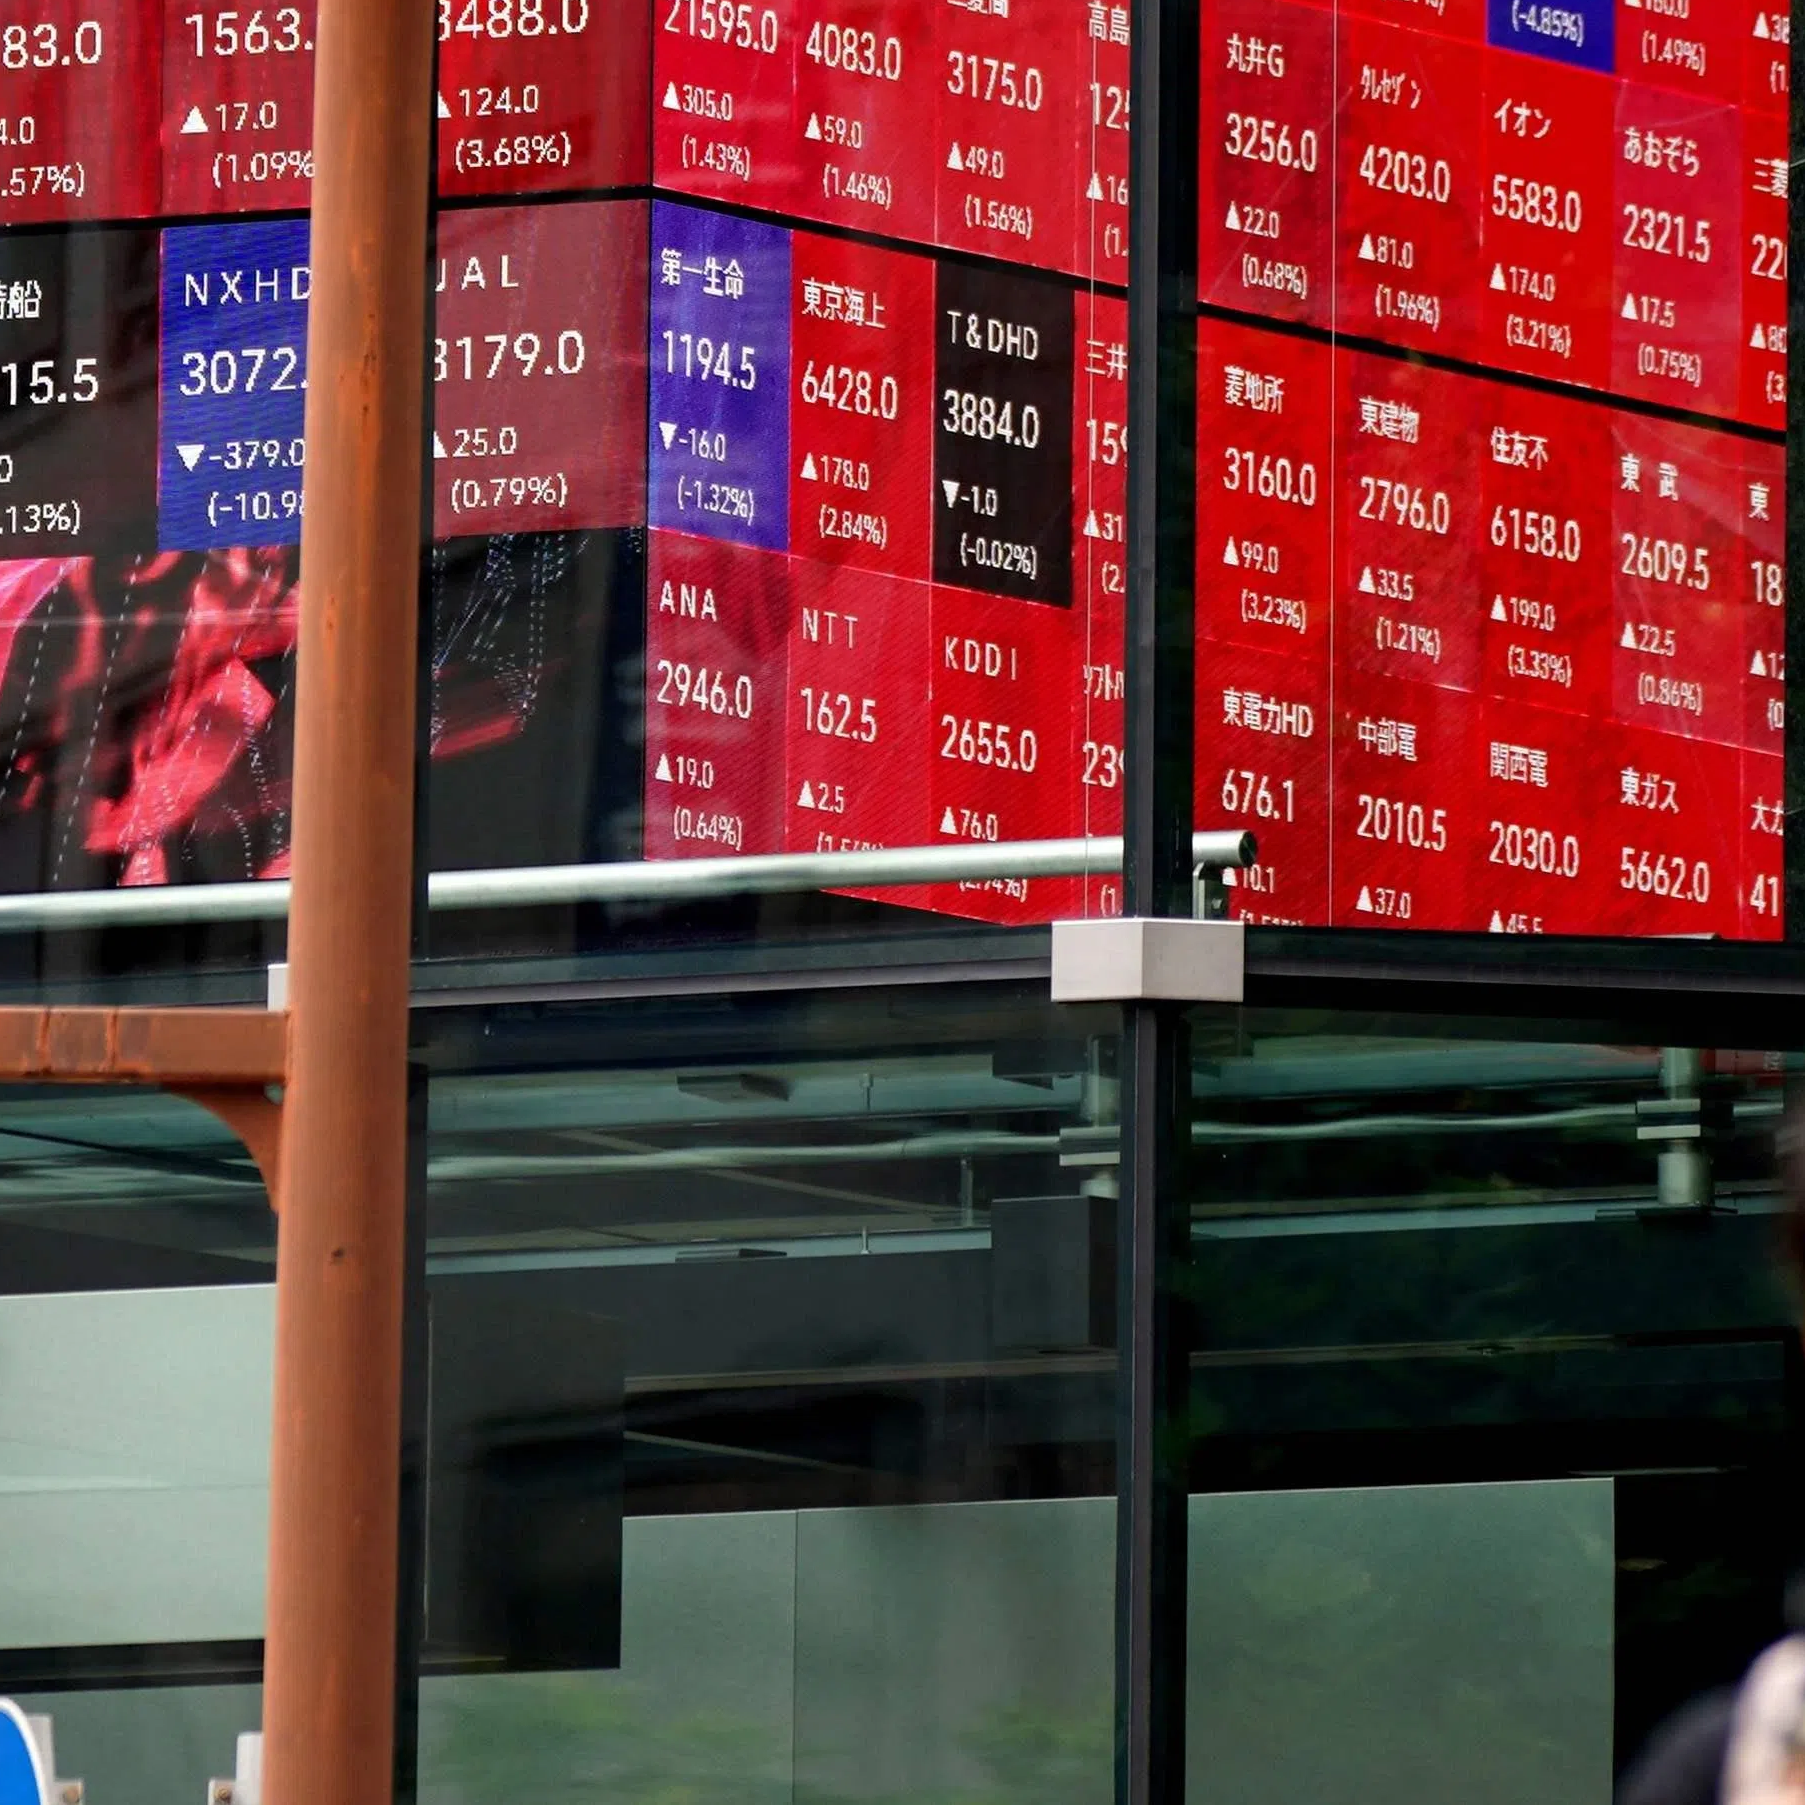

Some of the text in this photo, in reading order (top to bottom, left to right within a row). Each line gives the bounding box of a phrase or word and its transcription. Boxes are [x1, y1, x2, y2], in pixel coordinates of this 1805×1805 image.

[1227, 34, 1283, 77] 丸井G
[459, 85, 538, 116] 124.0
[683, 85, 732, 120] 305.0
[948, 51, 1042, 111] 3175.0
[1495, 99, 1550, 138] イオン
[1360, 145, 1450, 202] 4203.0
[1625, 127, 1699, 176] あおぞら
[661, 248, 744, 299] 第一生命
[803, 278, 885, 328] 東京海上
[802, 361, 897, 419] 6428.0
[1225, 366, 1283, 412] 菱地所
[453, 427, 516, 456] 25.0
[944, 390, 1039, 448] 3884.0
[1360, 396, 1419, 443] 東建物
[1491, 427, 1547, 467] 住友不
[1224, 448, 1315, 505] 3160.0
[819, 505, 886, 549] (2.84%)
[1360, 477, 1448, 534] 2796.0
[1622, 533, 1708, 590] 2609.5
[801, 688, 876, 742] 162.5
[1224, 688, 1313, 737] 東電力HD
[942, 715, 1036, 772] 2655.0
[1359, 717, 1416, 761] 中部電
[1491, 742, 1548, 787] 関西電
[1222, 770, 1292, 821] 676.1
[1621, 767, 1678, 812] 東ガス
[1490, 821, 1579, 877] 2030.0
